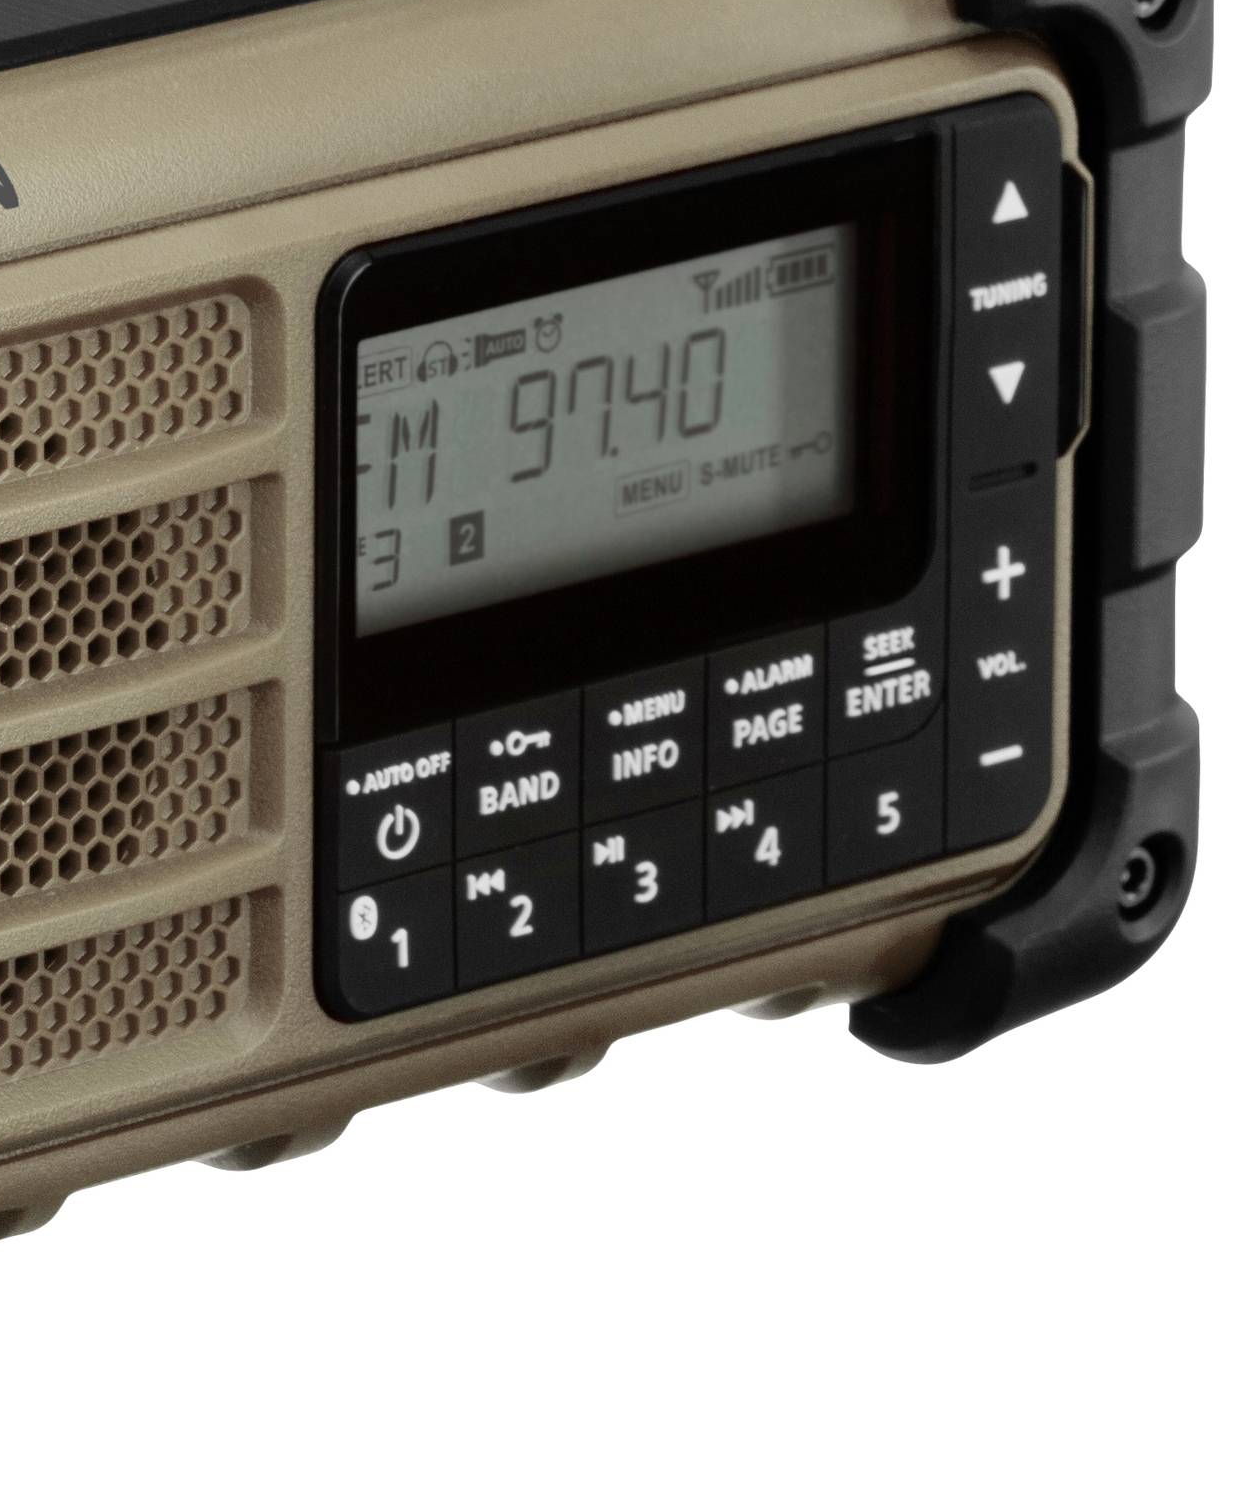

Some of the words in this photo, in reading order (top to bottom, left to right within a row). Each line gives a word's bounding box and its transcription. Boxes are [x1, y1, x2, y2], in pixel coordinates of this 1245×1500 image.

[970, 272, 1049, 313] TUNING
[358, 356, 408, 391] ERT
[485, 334, 524, 358] AUTO
[510, 327, 727, 483] 97.40
[622, 469, 684, 507] MENU
[700, 443, 782, 487] S-MUTE
[863, 626, 916, 661] SEEK
[741, 654, 815, 696] ALARM
[978, 651, 1028, 681] VOL.
[622, 690, 687, 728] MENU
[846, 669, 932, 719] ENTER
[734, 704, 805, 750] PAGE
[362, 762, 414, 795] AUTO
[415, 751, 451, 779] OFF
[613, 739, 681, 782] INFO
[480, 771, 562, 817] BAND
[877, 791, 903, 836] 5
[755, 825, 783, 867] 4
[635, 861, 660, 905] 3
[509, 895, 535, 938] 2
[390, 928, 410, 969] 1
